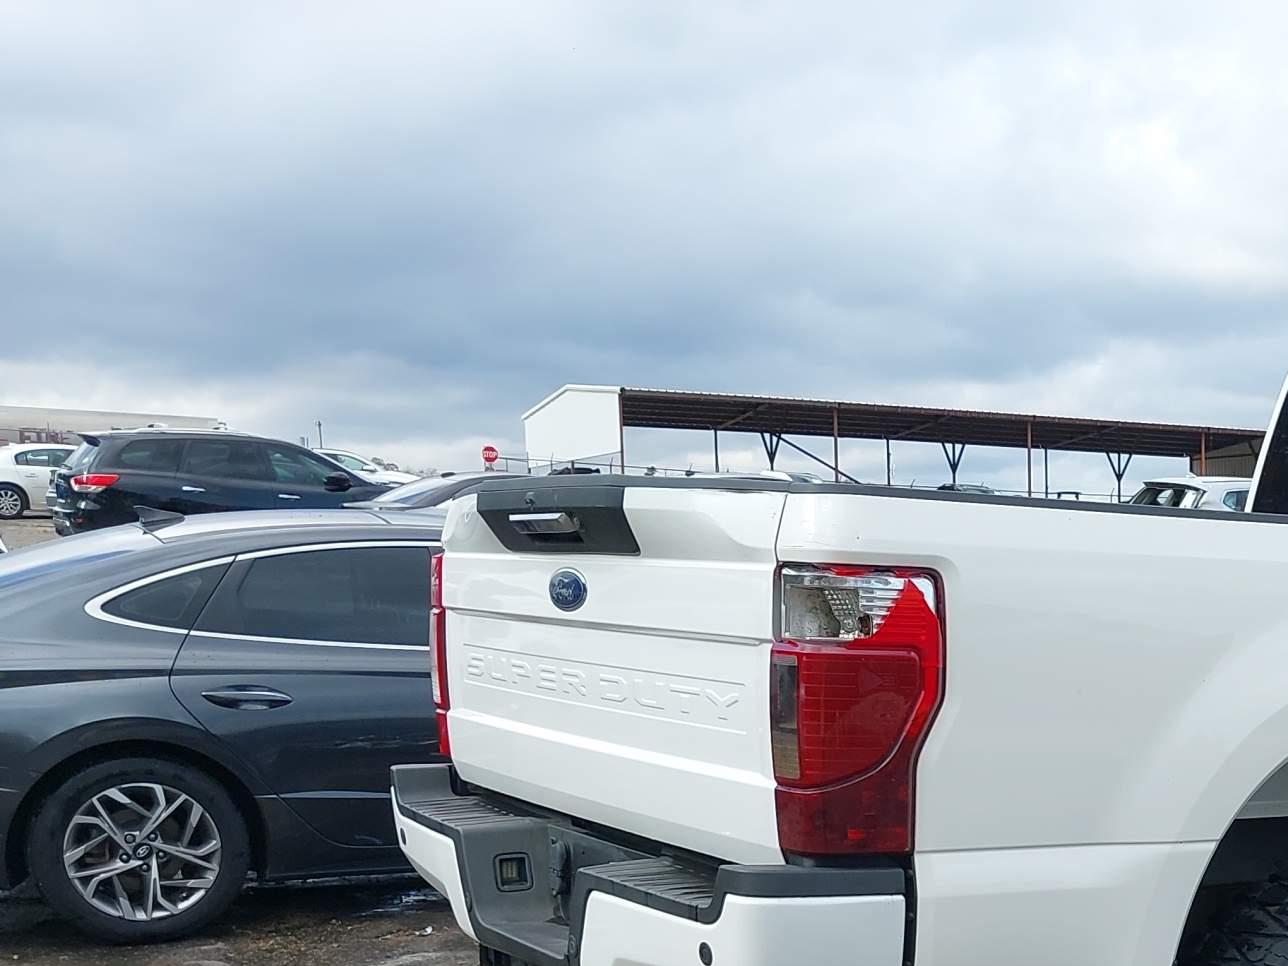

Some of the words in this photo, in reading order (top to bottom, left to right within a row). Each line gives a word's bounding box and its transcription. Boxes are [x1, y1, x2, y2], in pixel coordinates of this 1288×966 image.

[483, 450, 498, 458] STOP
[552, 577, 576, 601] Ford
[466, 652, 588, 697] SUPER
[599, 673, 740, 721] DUTY
